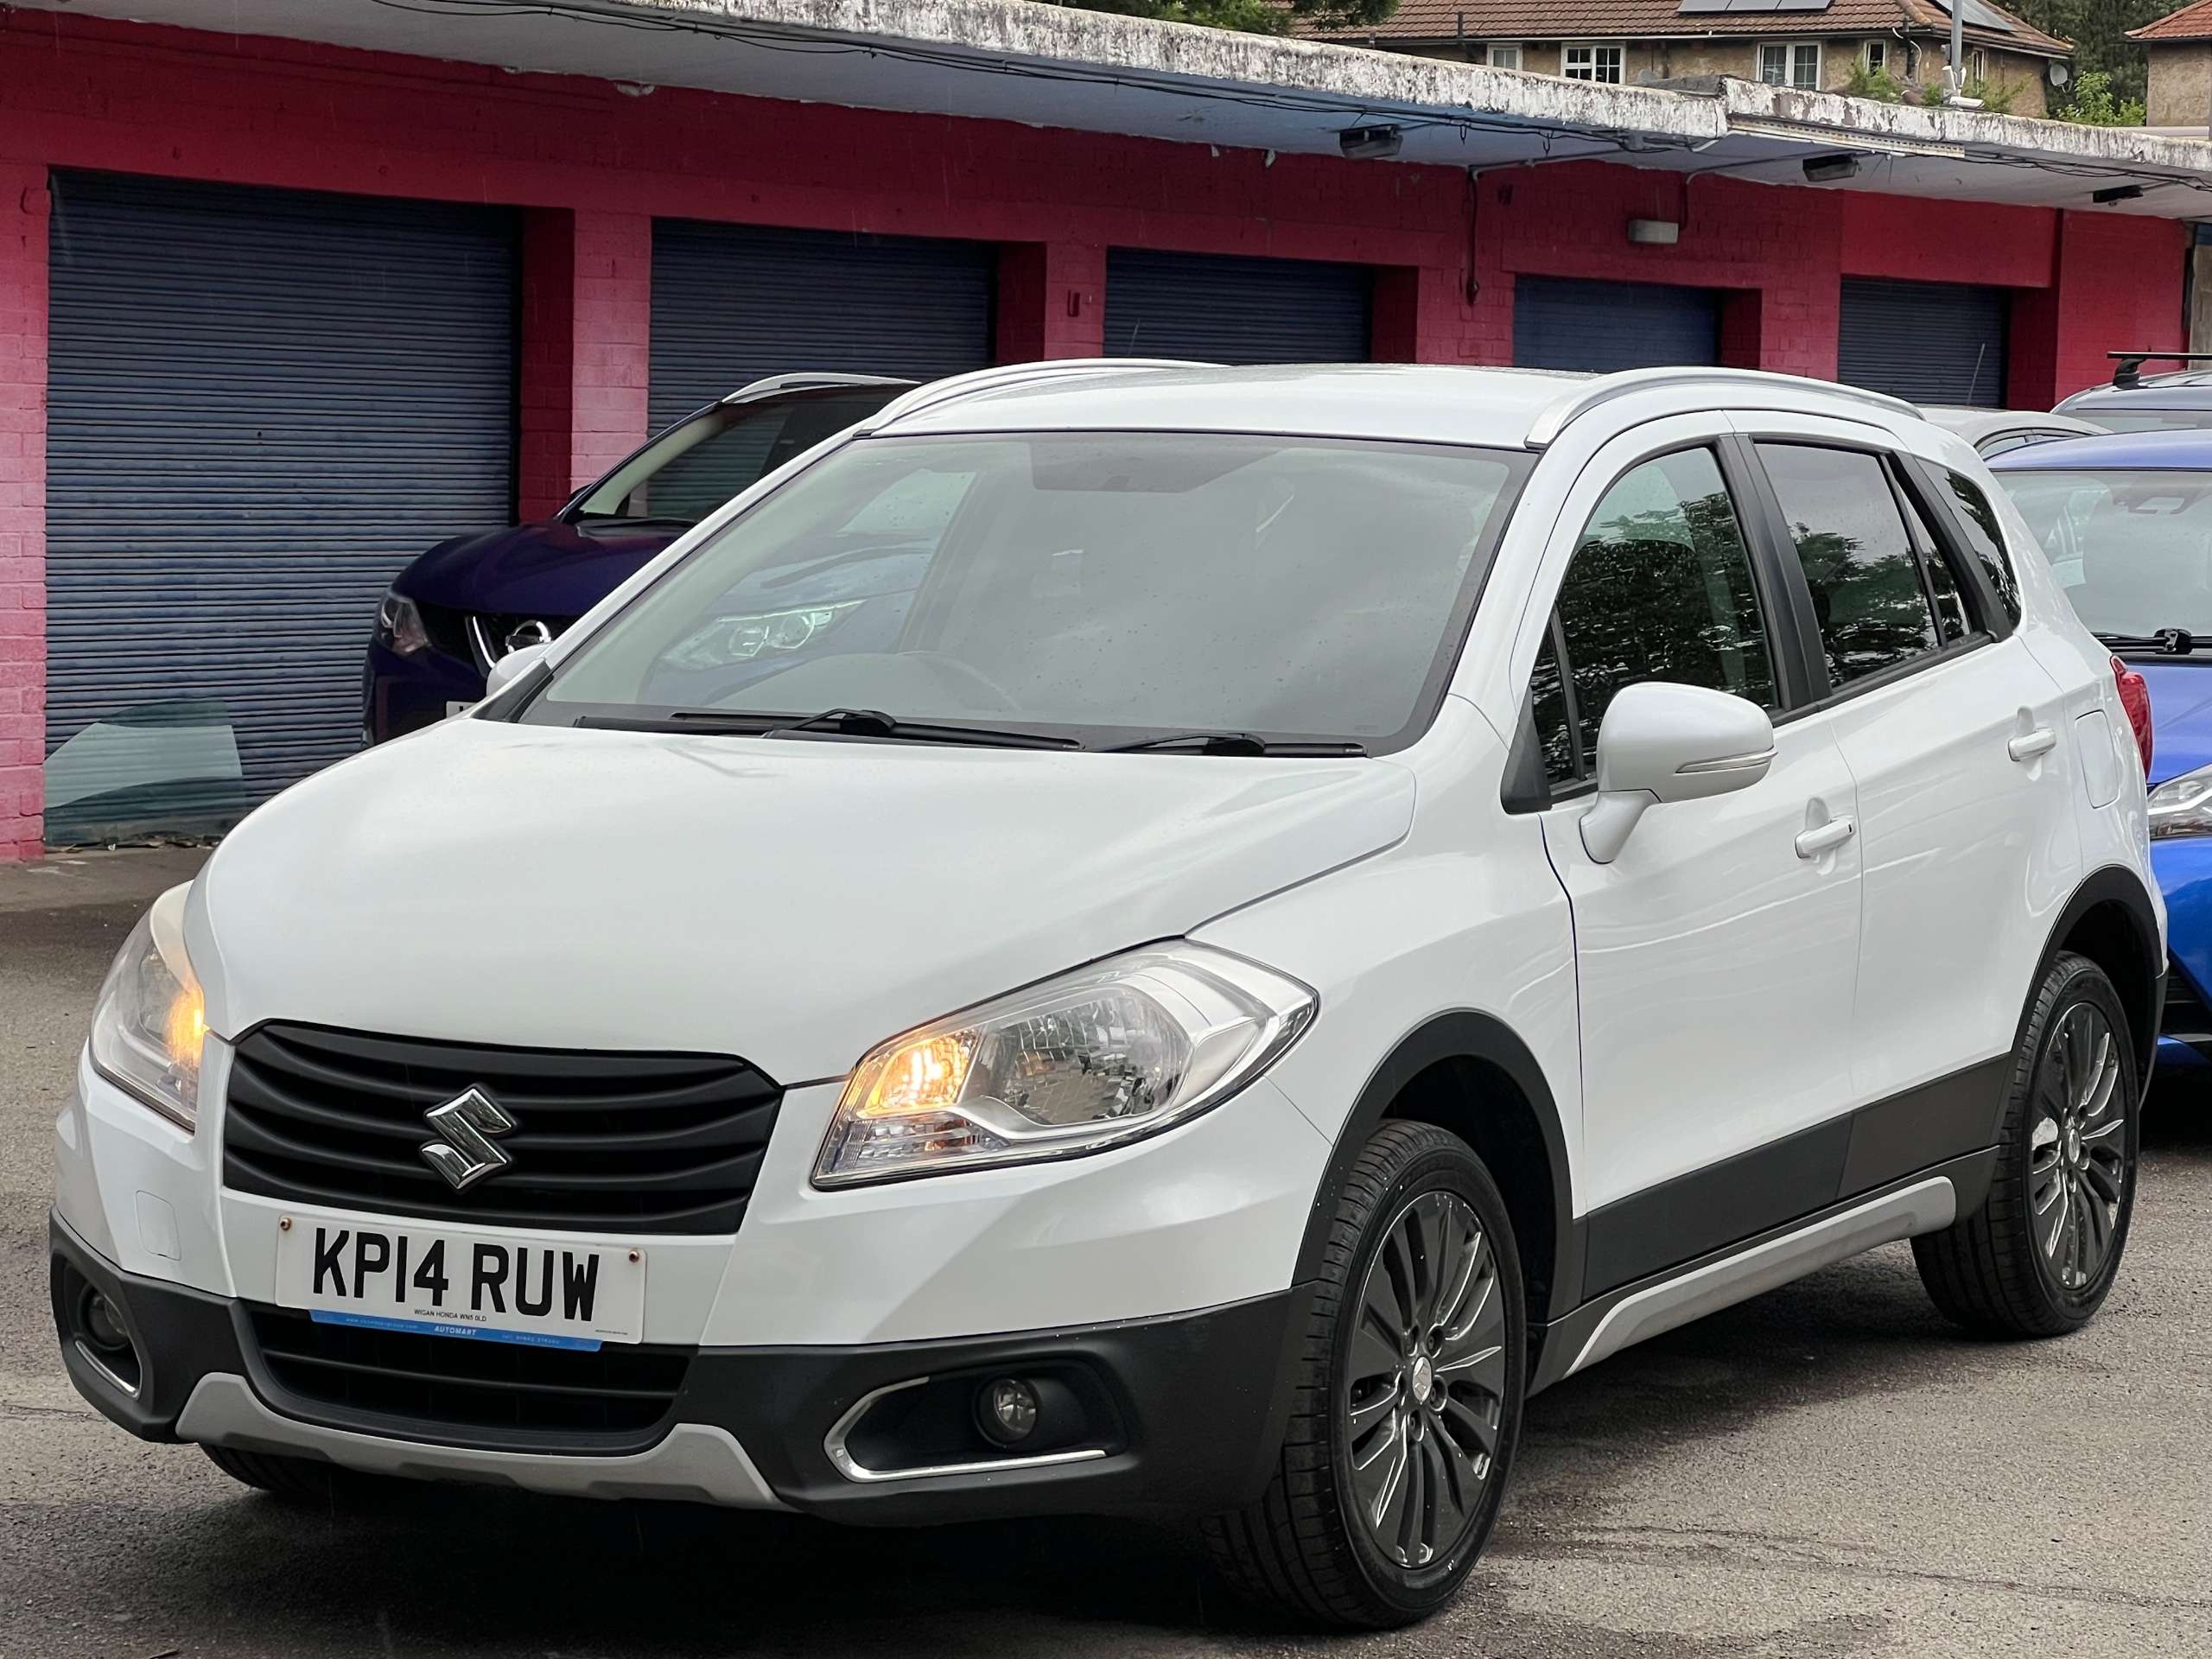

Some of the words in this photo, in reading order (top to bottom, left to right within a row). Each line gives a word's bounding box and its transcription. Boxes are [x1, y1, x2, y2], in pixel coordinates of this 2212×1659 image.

[313, 1227, 449, 1307] KP14
[470, 1243, 600, 1322] RUW
[415, 1308, 435, 1317] WIGAN
[435, 1325, 476, 1336] AUTOMART
